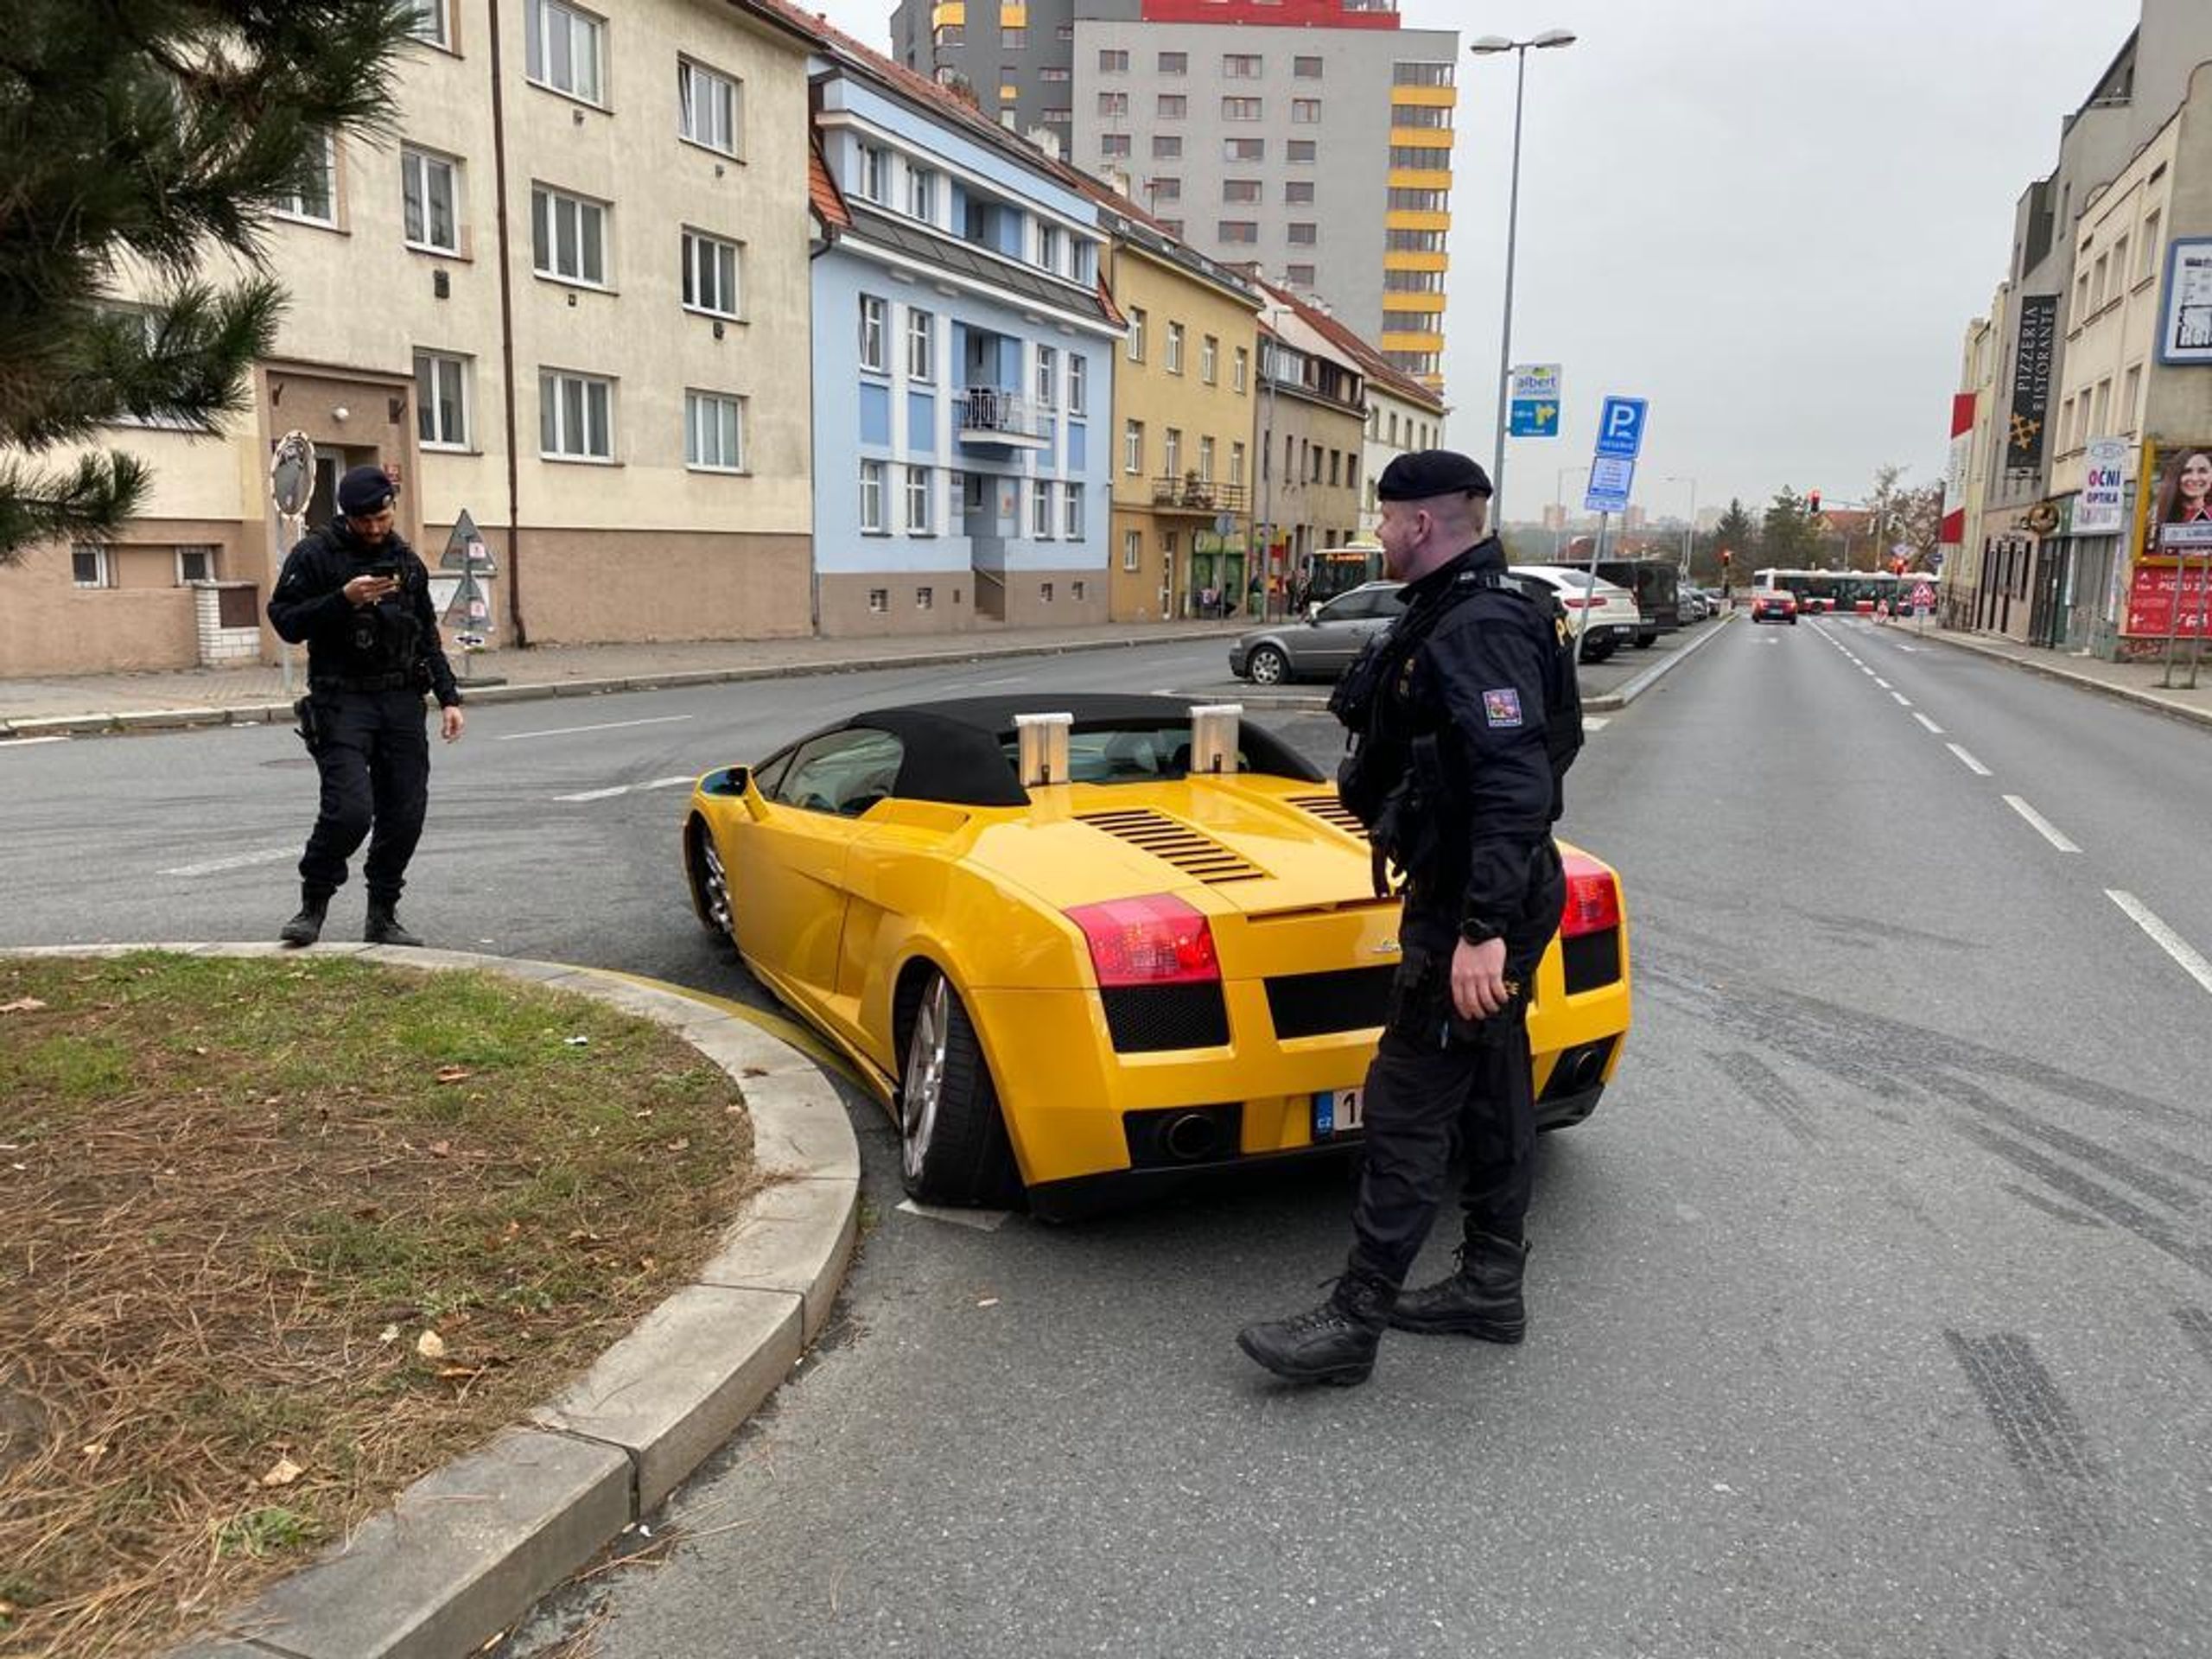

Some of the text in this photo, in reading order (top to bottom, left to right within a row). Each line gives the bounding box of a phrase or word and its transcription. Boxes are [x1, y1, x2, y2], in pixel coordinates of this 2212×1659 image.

[2018, 305, 2038, 391] PIZZERIA
[2031, 304, 2055, 411] RISTORANTE
[1516, 375, 1557, 389] albert
[1609, 404, 1636, 436] P
[2088, 465, 2122, 487] OČNÍ
[2087, 492, 2119, 504] OPTIKA
[1344, 1092, 1363, 1124] 1
[1318, 1116, 1332, 1128] CZ
